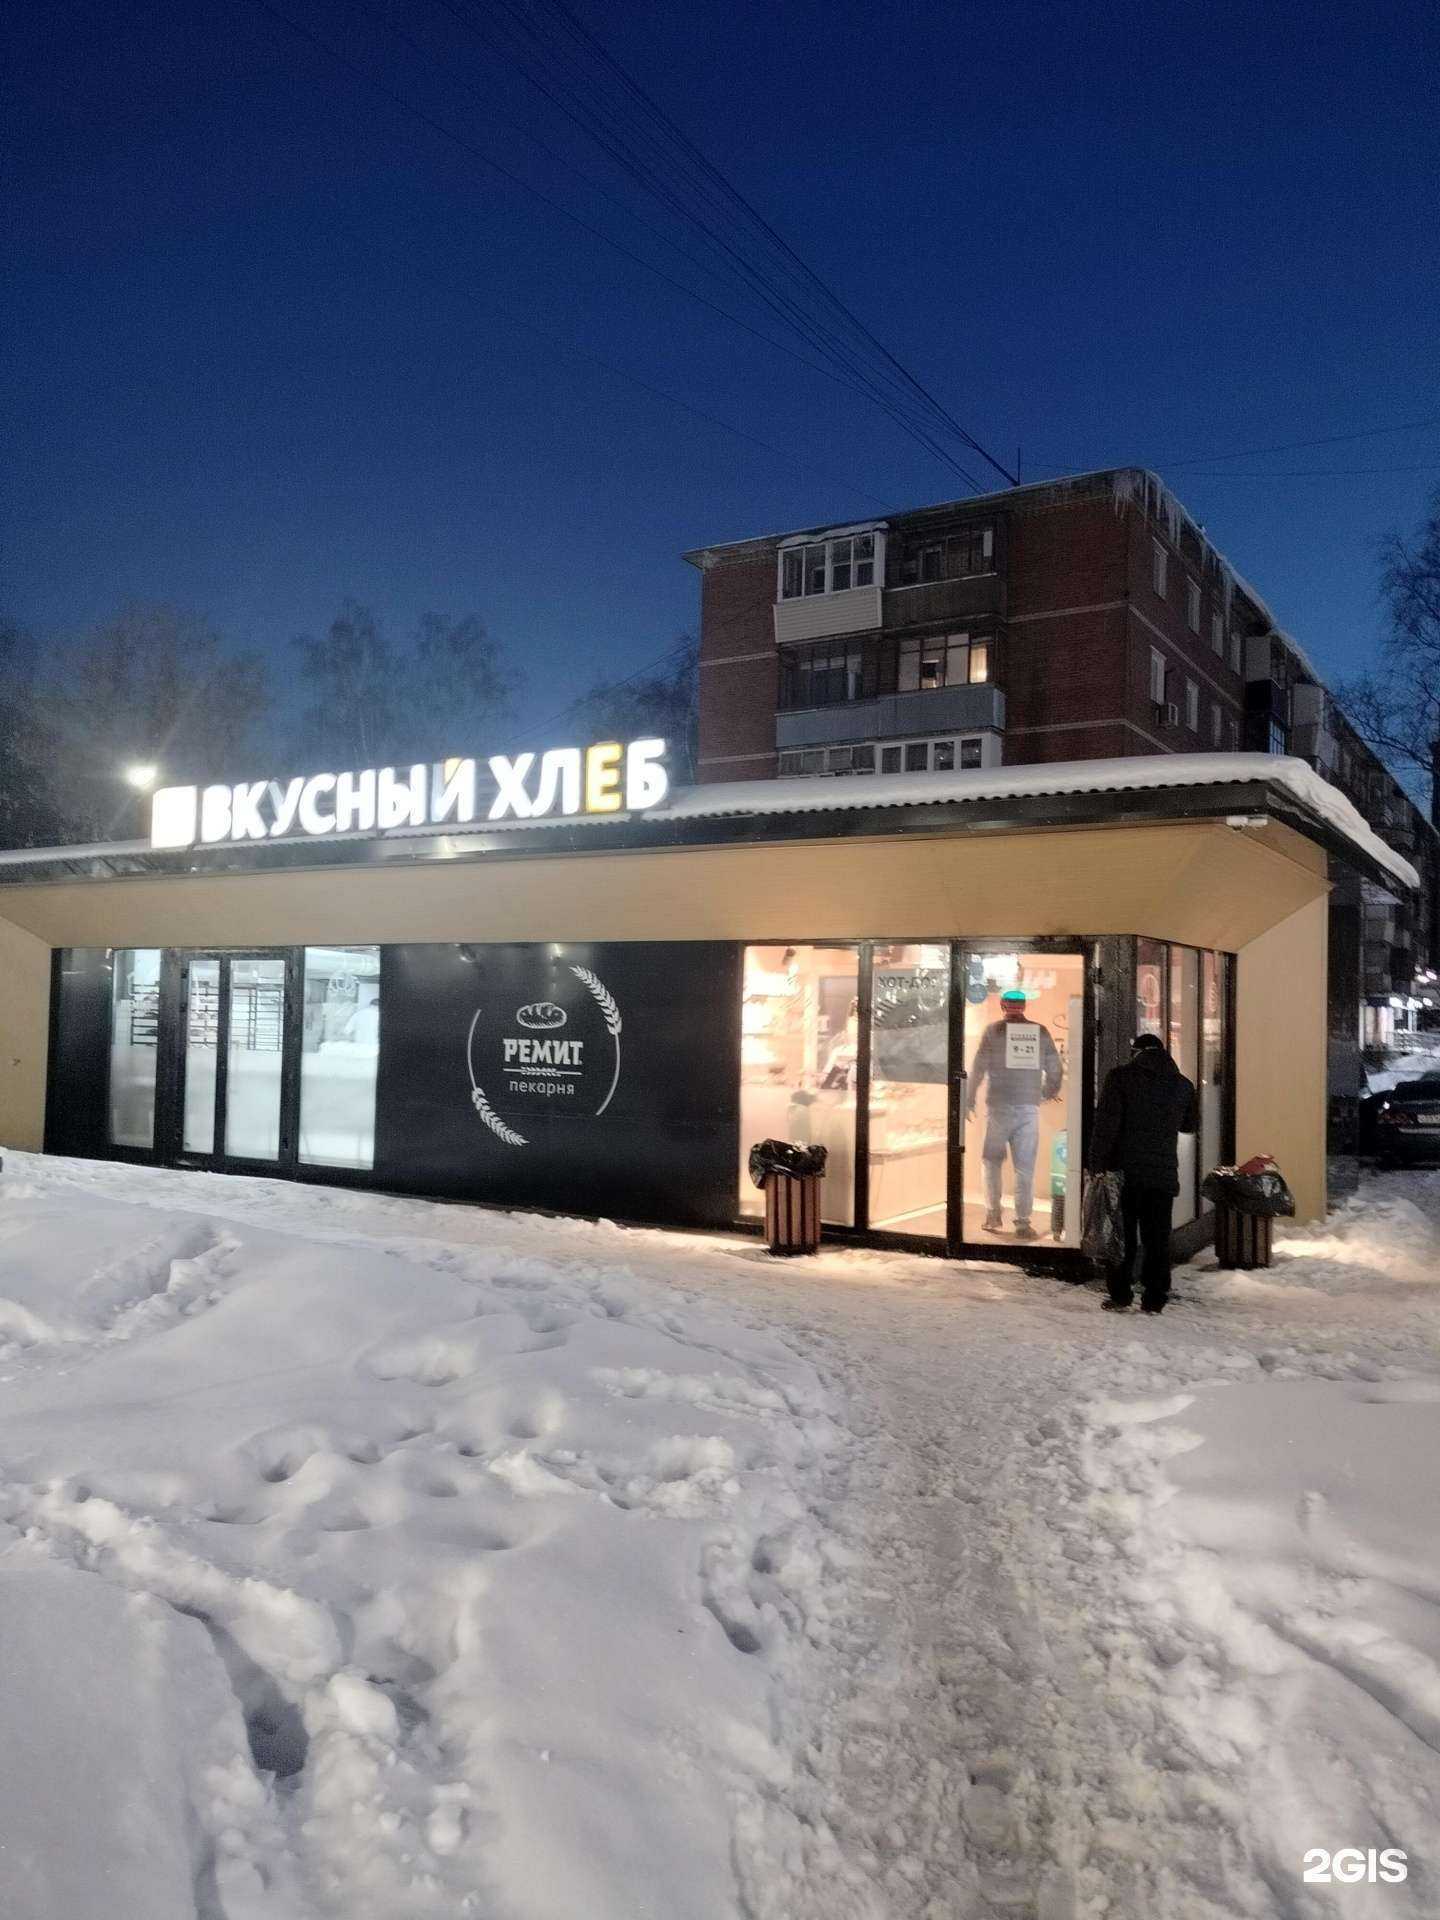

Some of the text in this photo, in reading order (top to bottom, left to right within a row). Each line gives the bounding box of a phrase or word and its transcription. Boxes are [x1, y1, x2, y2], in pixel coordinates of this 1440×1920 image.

[201, 737, 668, 844] ВКУСНЫЙ ХЛЕБ
[503, 1038, 583, 1065] РЕМИТ
[509, 1079, 574, 1097] пекарня
